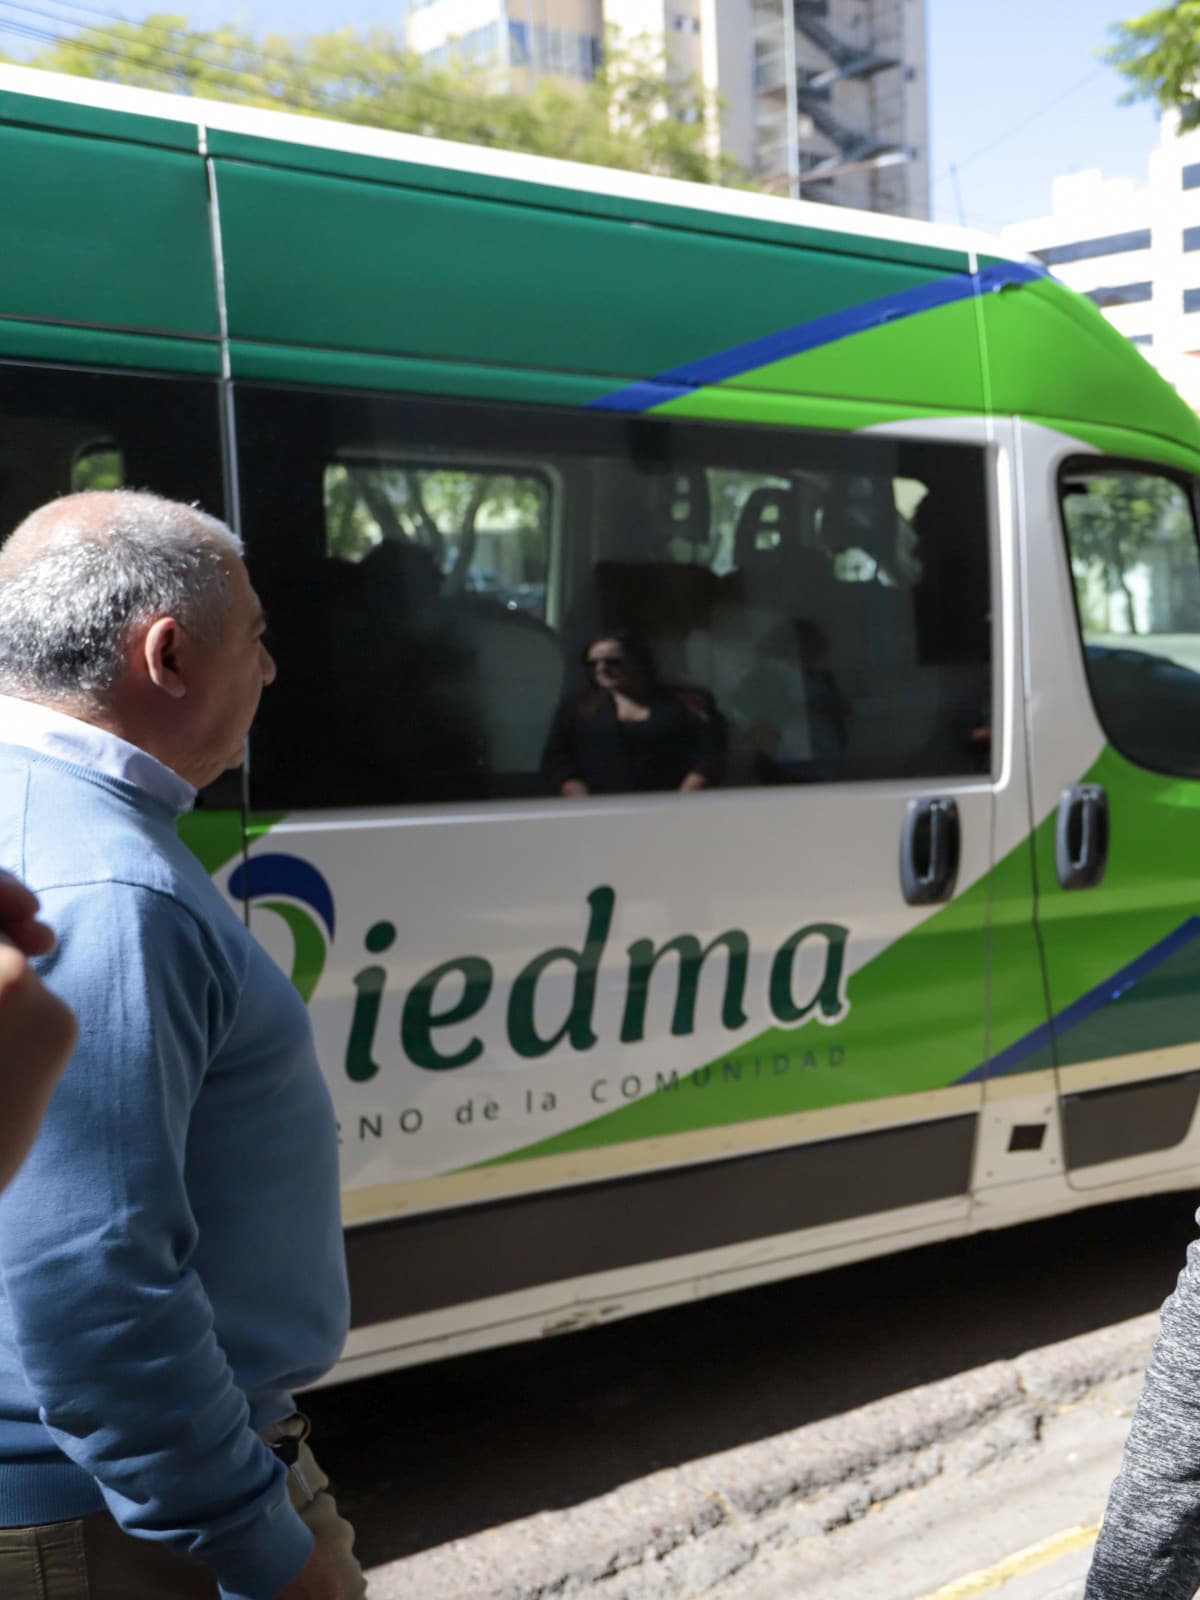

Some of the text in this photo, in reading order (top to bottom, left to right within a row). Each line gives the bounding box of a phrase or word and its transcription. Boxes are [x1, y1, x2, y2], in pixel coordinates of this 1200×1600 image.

[455, 1099, 499, 1125] de
[526, 1089, 556, 1113] la
[590, 1045, 846, 1104] COMUNIDAD
